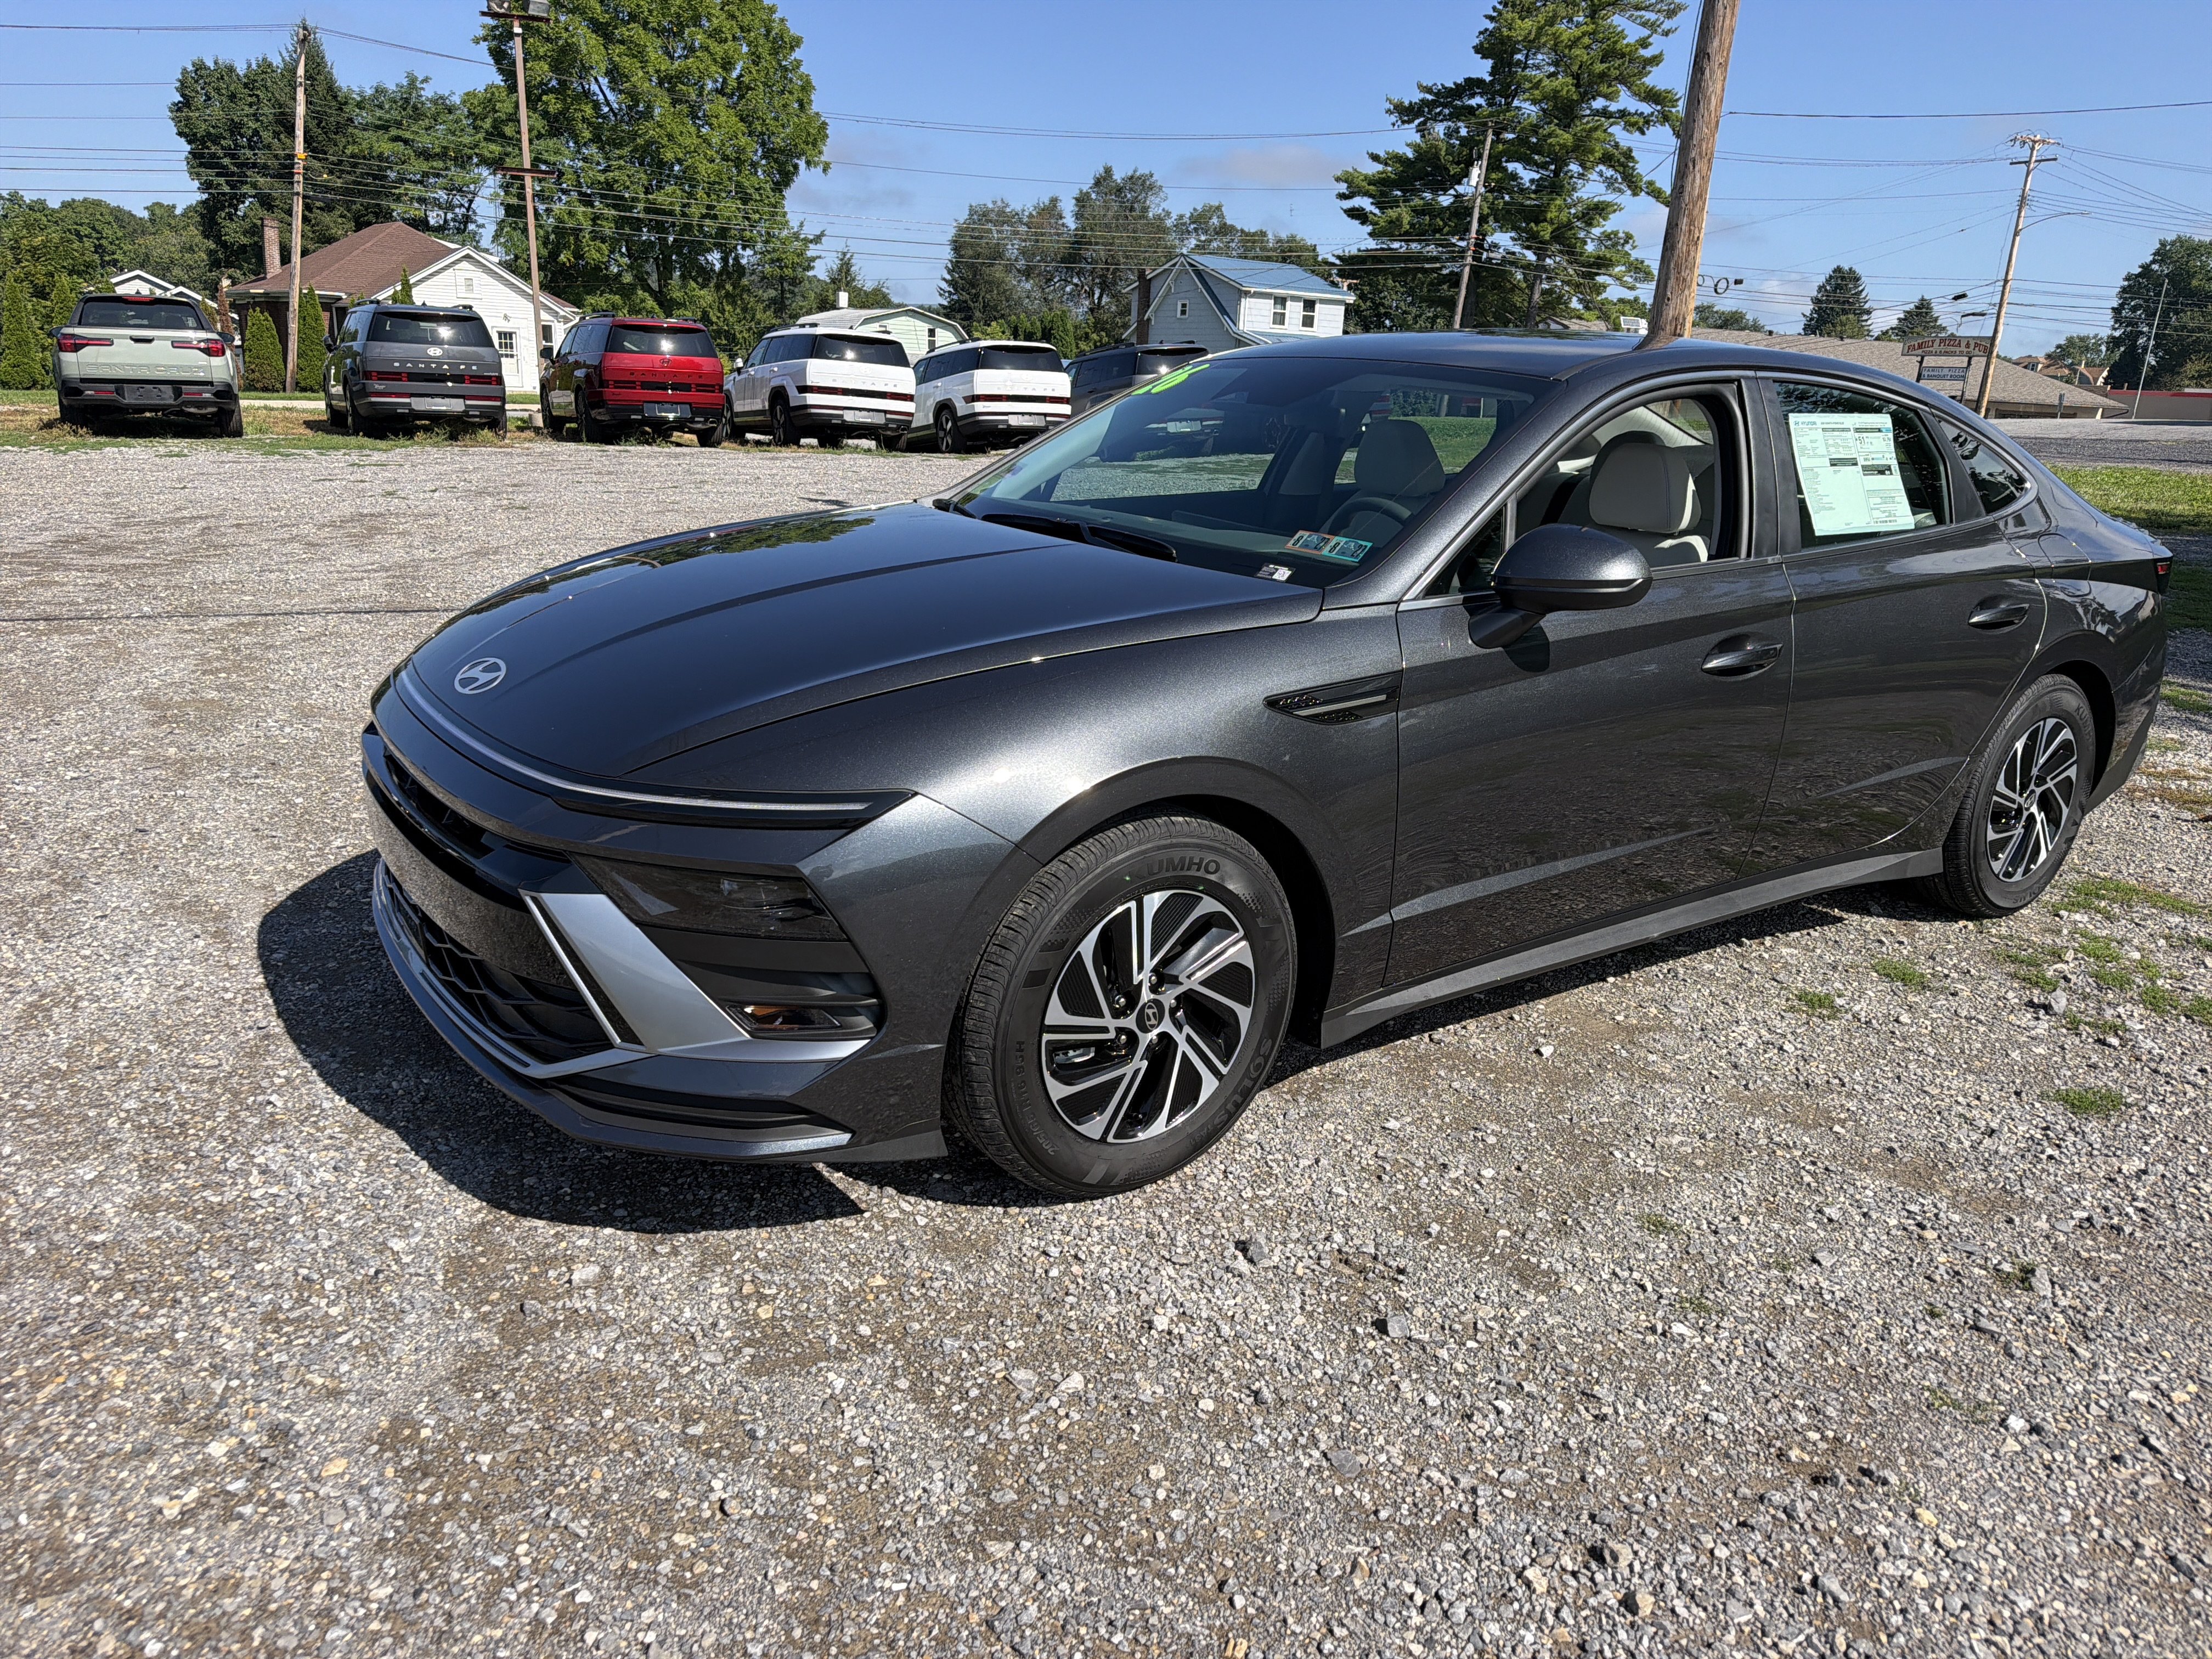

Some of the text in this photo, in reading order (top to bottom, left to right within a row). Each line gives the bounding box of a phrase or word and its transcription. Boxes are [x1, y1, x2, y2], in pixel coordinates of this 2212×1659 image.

[1906, 338, 1989, 354] FAMILY PIZZA & PUB
[86, 364, 205, 376] SANTA CRUZ
[1292, 535, 1304, 546] 8
[1328, 541, 1341, 554] 8
[1128, 856, 1221, 880] KUMHO
[1214, 1038, 1272, 1128] SOLUS
